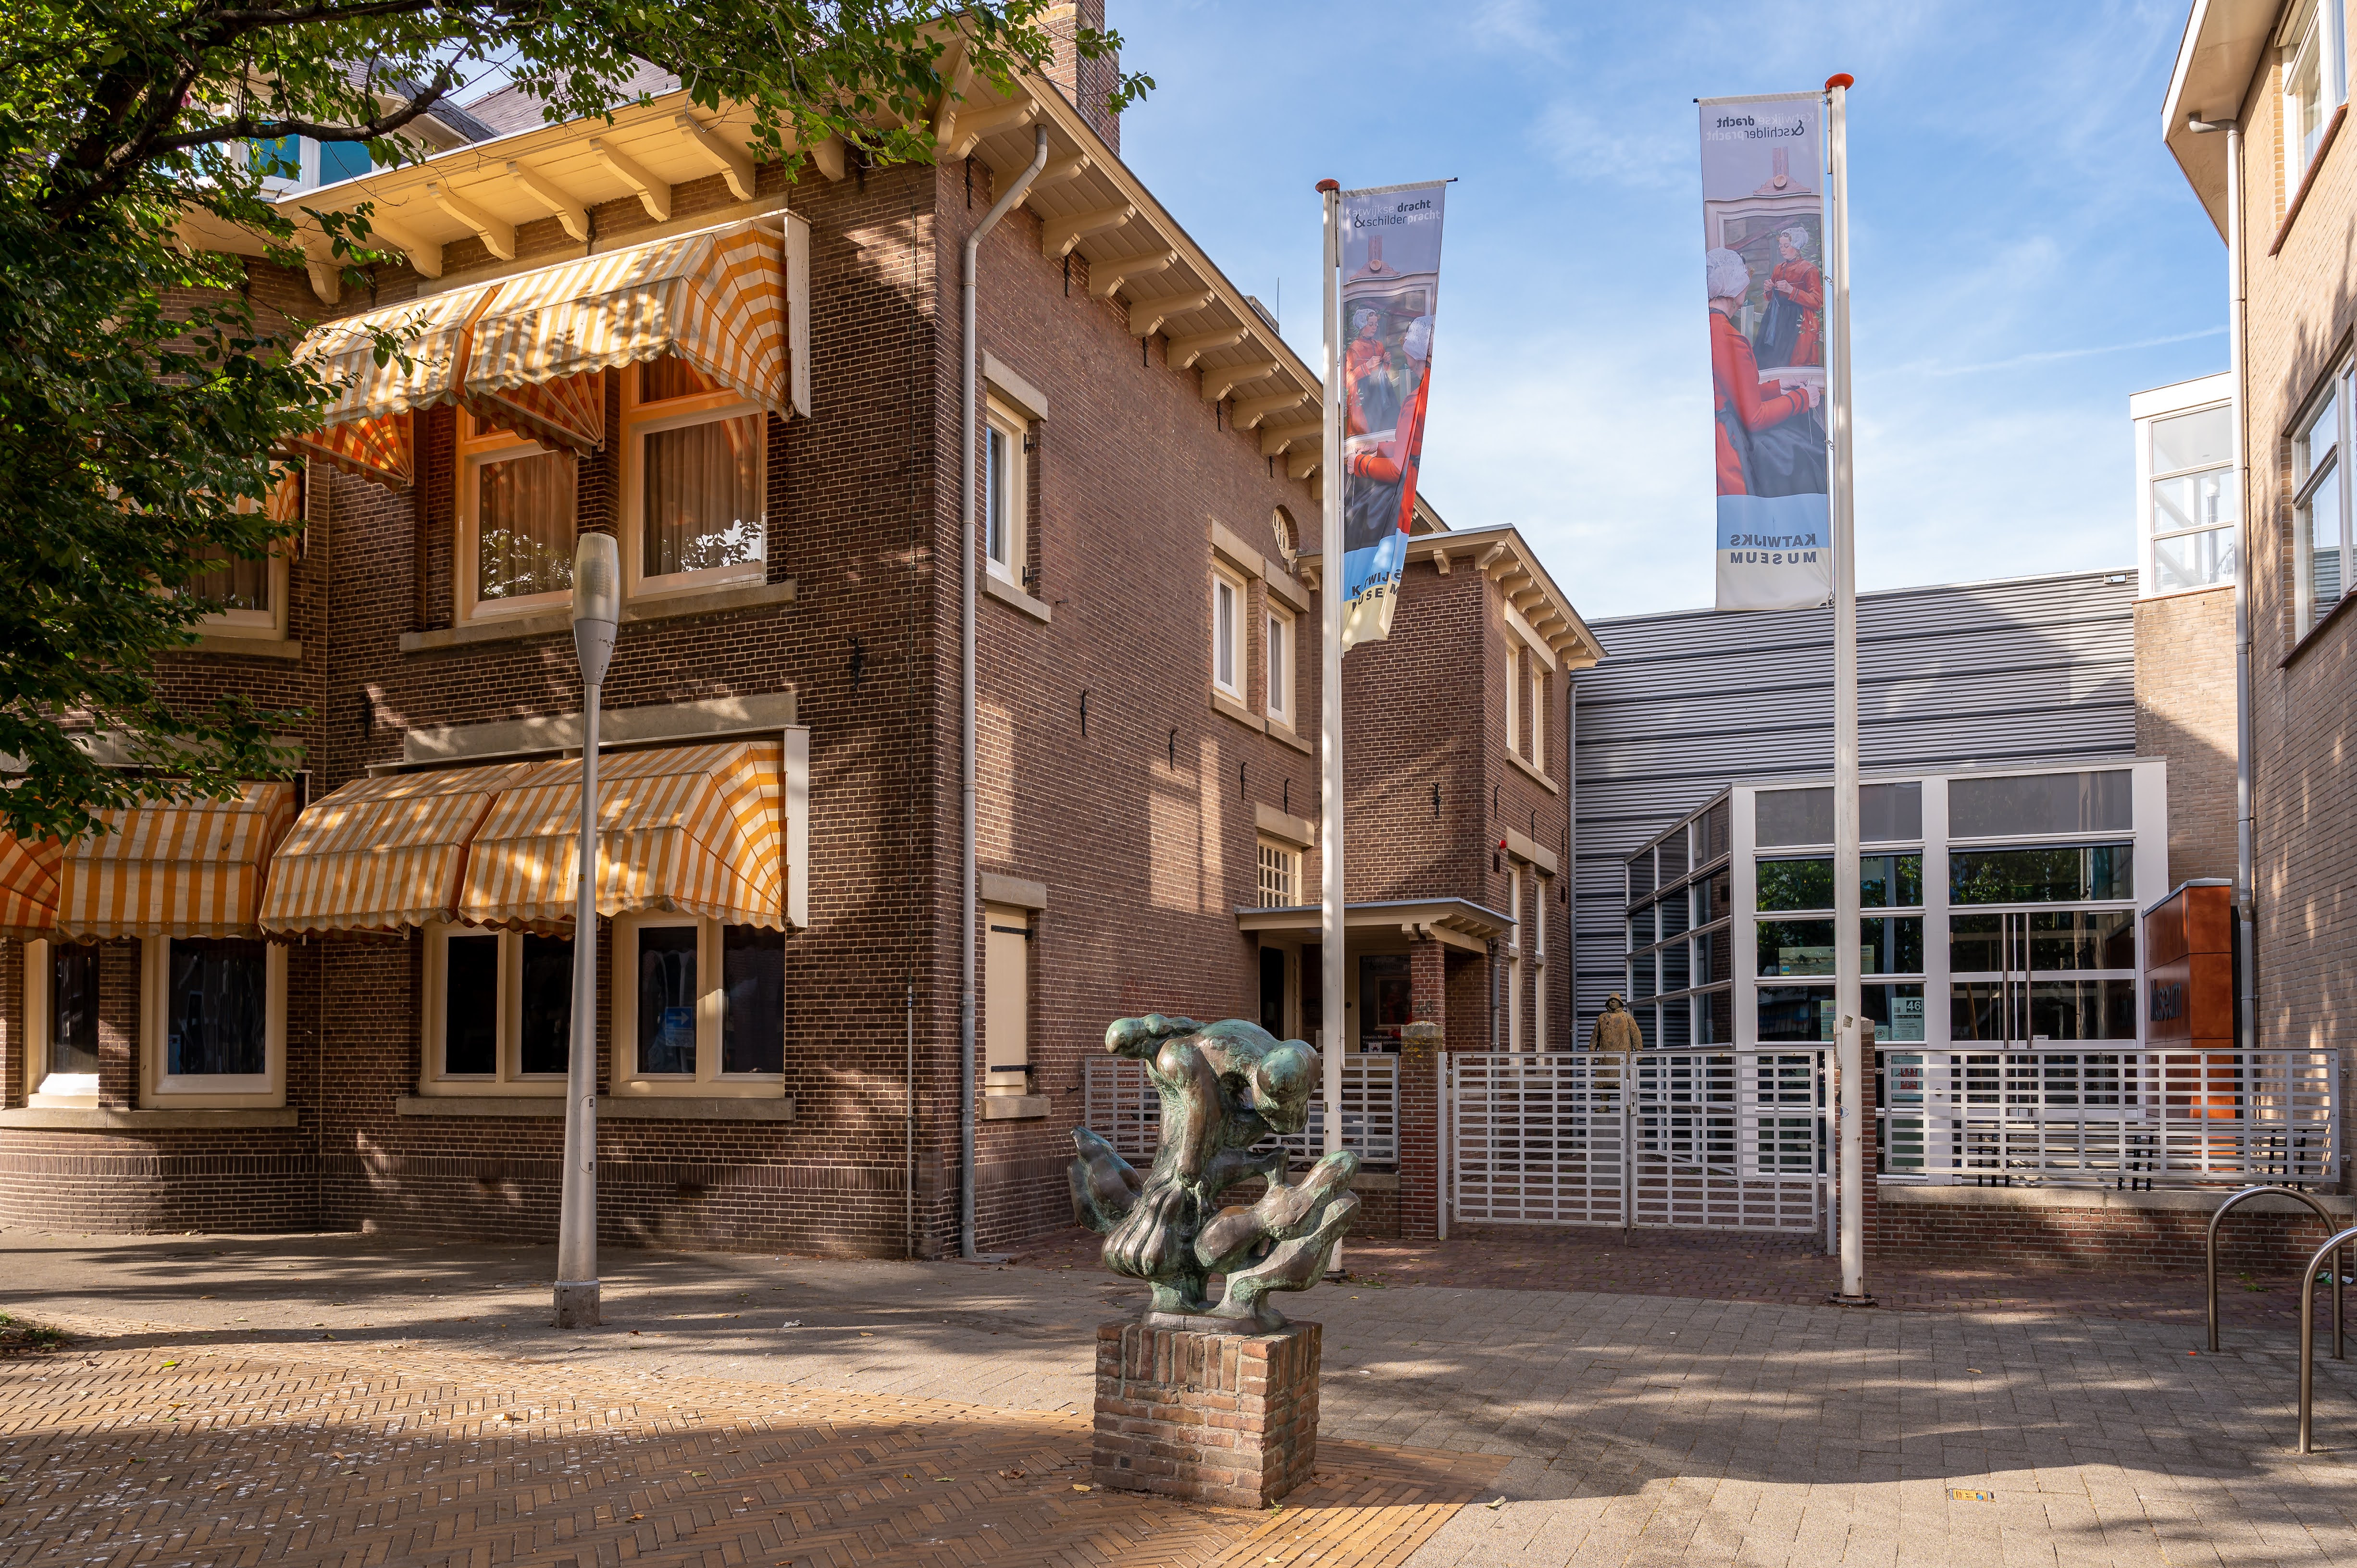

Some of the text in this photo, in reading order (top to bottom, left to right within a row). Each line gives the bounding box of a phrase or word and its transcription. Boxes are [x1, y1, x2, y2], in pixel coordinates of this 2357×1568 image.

[1346, 200, 1431, 218] Katwijkse dracht
[1415, 1000, 1434, 1013] 46
[1907, 1001, 1921, 1011] 46
[2149, 979, 2181, 1022] Museum
